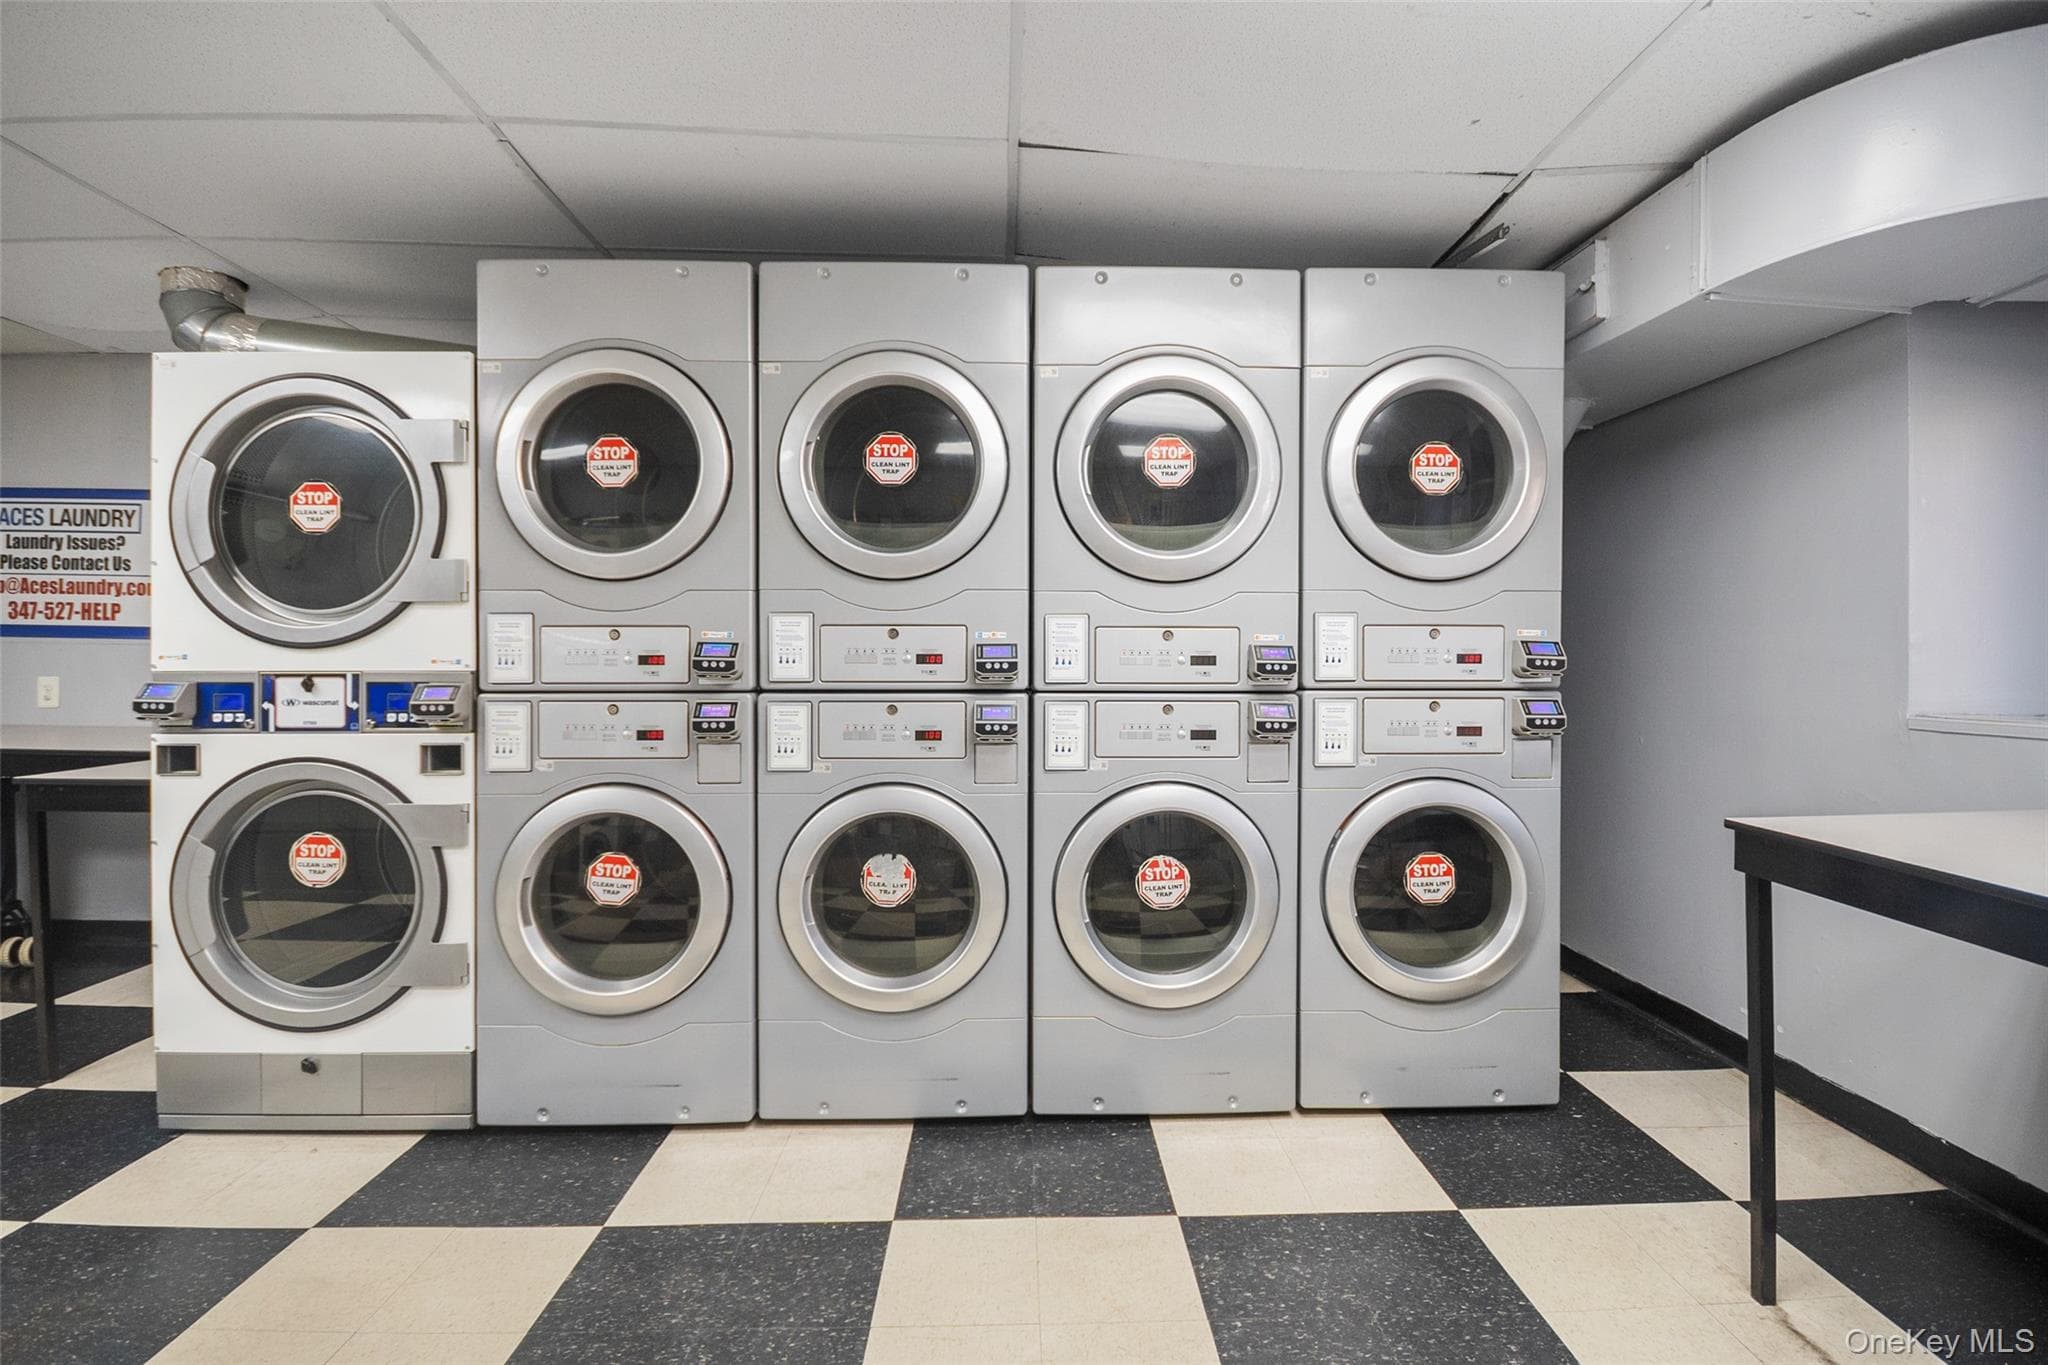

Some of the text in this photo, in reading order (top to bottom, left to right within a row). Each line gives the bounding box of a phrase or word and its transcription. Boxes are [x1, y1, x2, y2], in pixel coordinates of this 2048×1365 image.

[593, 446, 630, 460] STOP
[873, 444, 909, 457] STOP
[1151, 446, 1187, 460] STOP
[1419, 454, 1454, 466] STOP
[297, 491, 334, 505] STOP
[0, 507, 136, 527] ACES LAUNDRY
[6, 534, 126, 551] Laundry Issues?
[0, 554, 132, 572] Please Contact Us
[8, 601, 122, 621] 347-527-HELP
[299, 844, 336, 858] STOP
[595, 863, 632, 878] STOP
[1145, 866, 1180, 880] STOP
[1413, 863, 1448, 877] STOP
[592, 880, 615, 888] CLEAN
[1144, 884, 1166, 892] CLEAN
